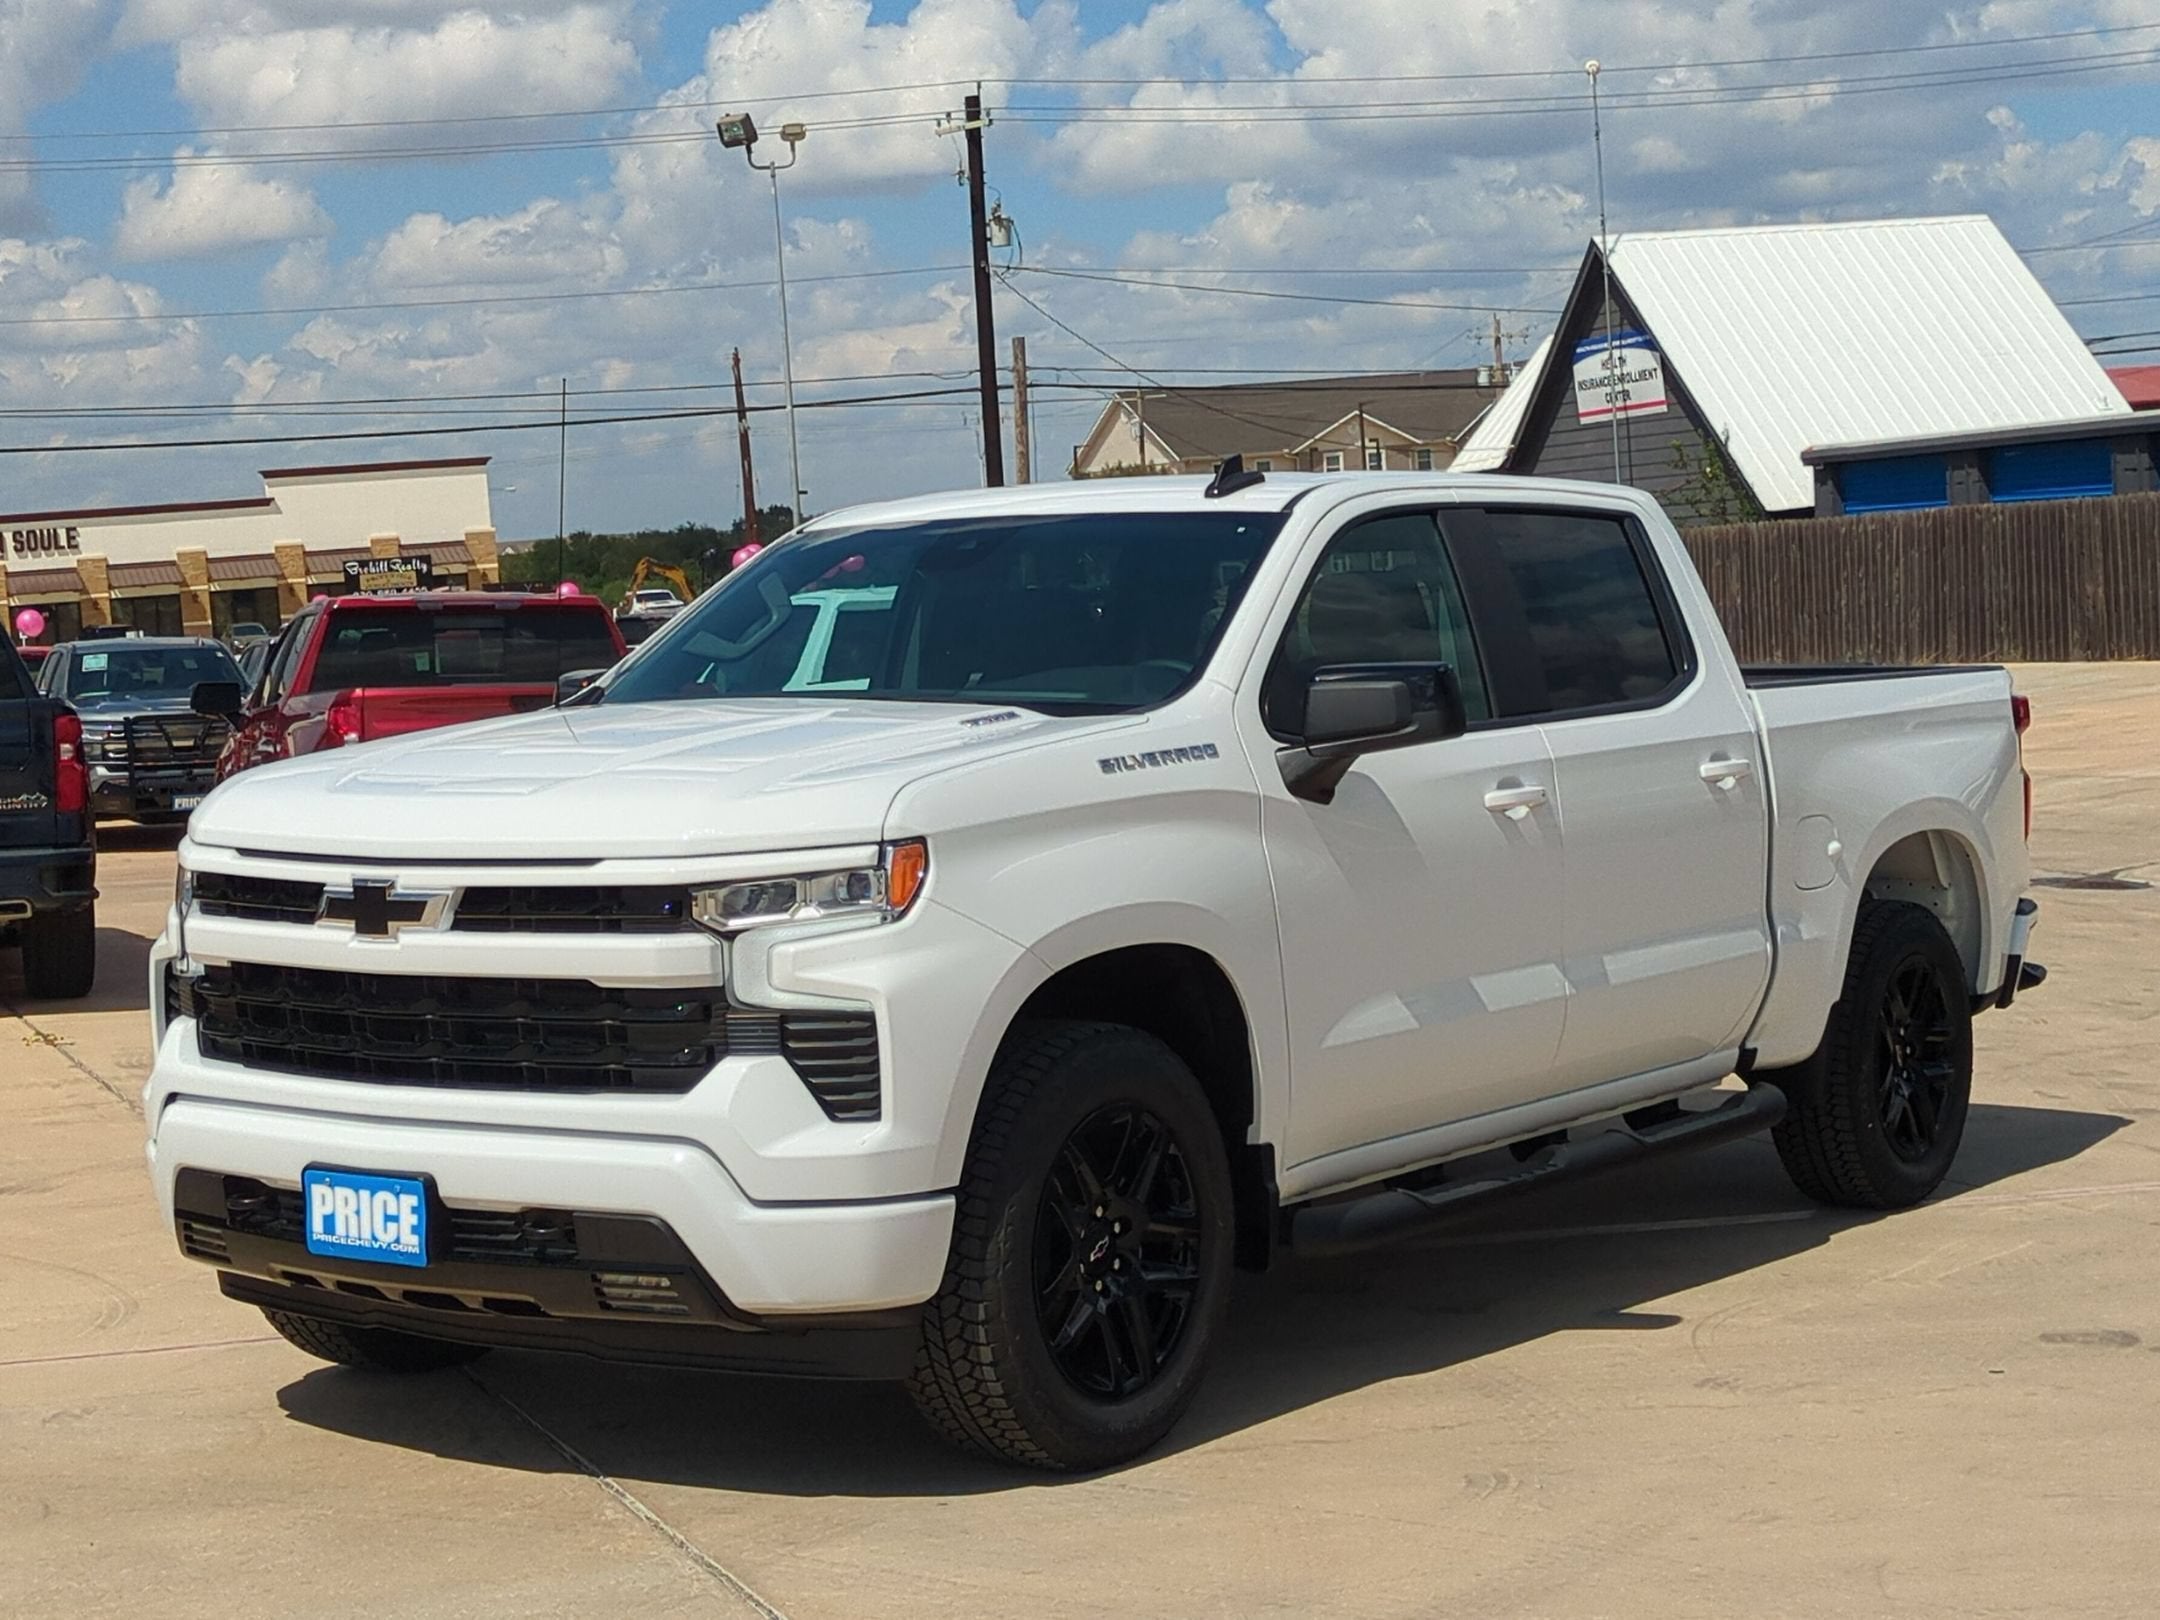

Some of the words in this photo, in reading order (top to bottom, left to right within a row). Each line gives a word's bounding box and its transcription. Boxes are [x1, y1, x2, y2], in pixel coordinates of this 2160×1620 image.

[12, 527, 79, 553] SOULE
[1098, 743, 1220, 774] SILVERADO
[175, 797, 203, 809] PRIC
[311, 1184, 419, 1246] PRICE
[312, 1233, 420, 1254] PRICECHEVY.COM
